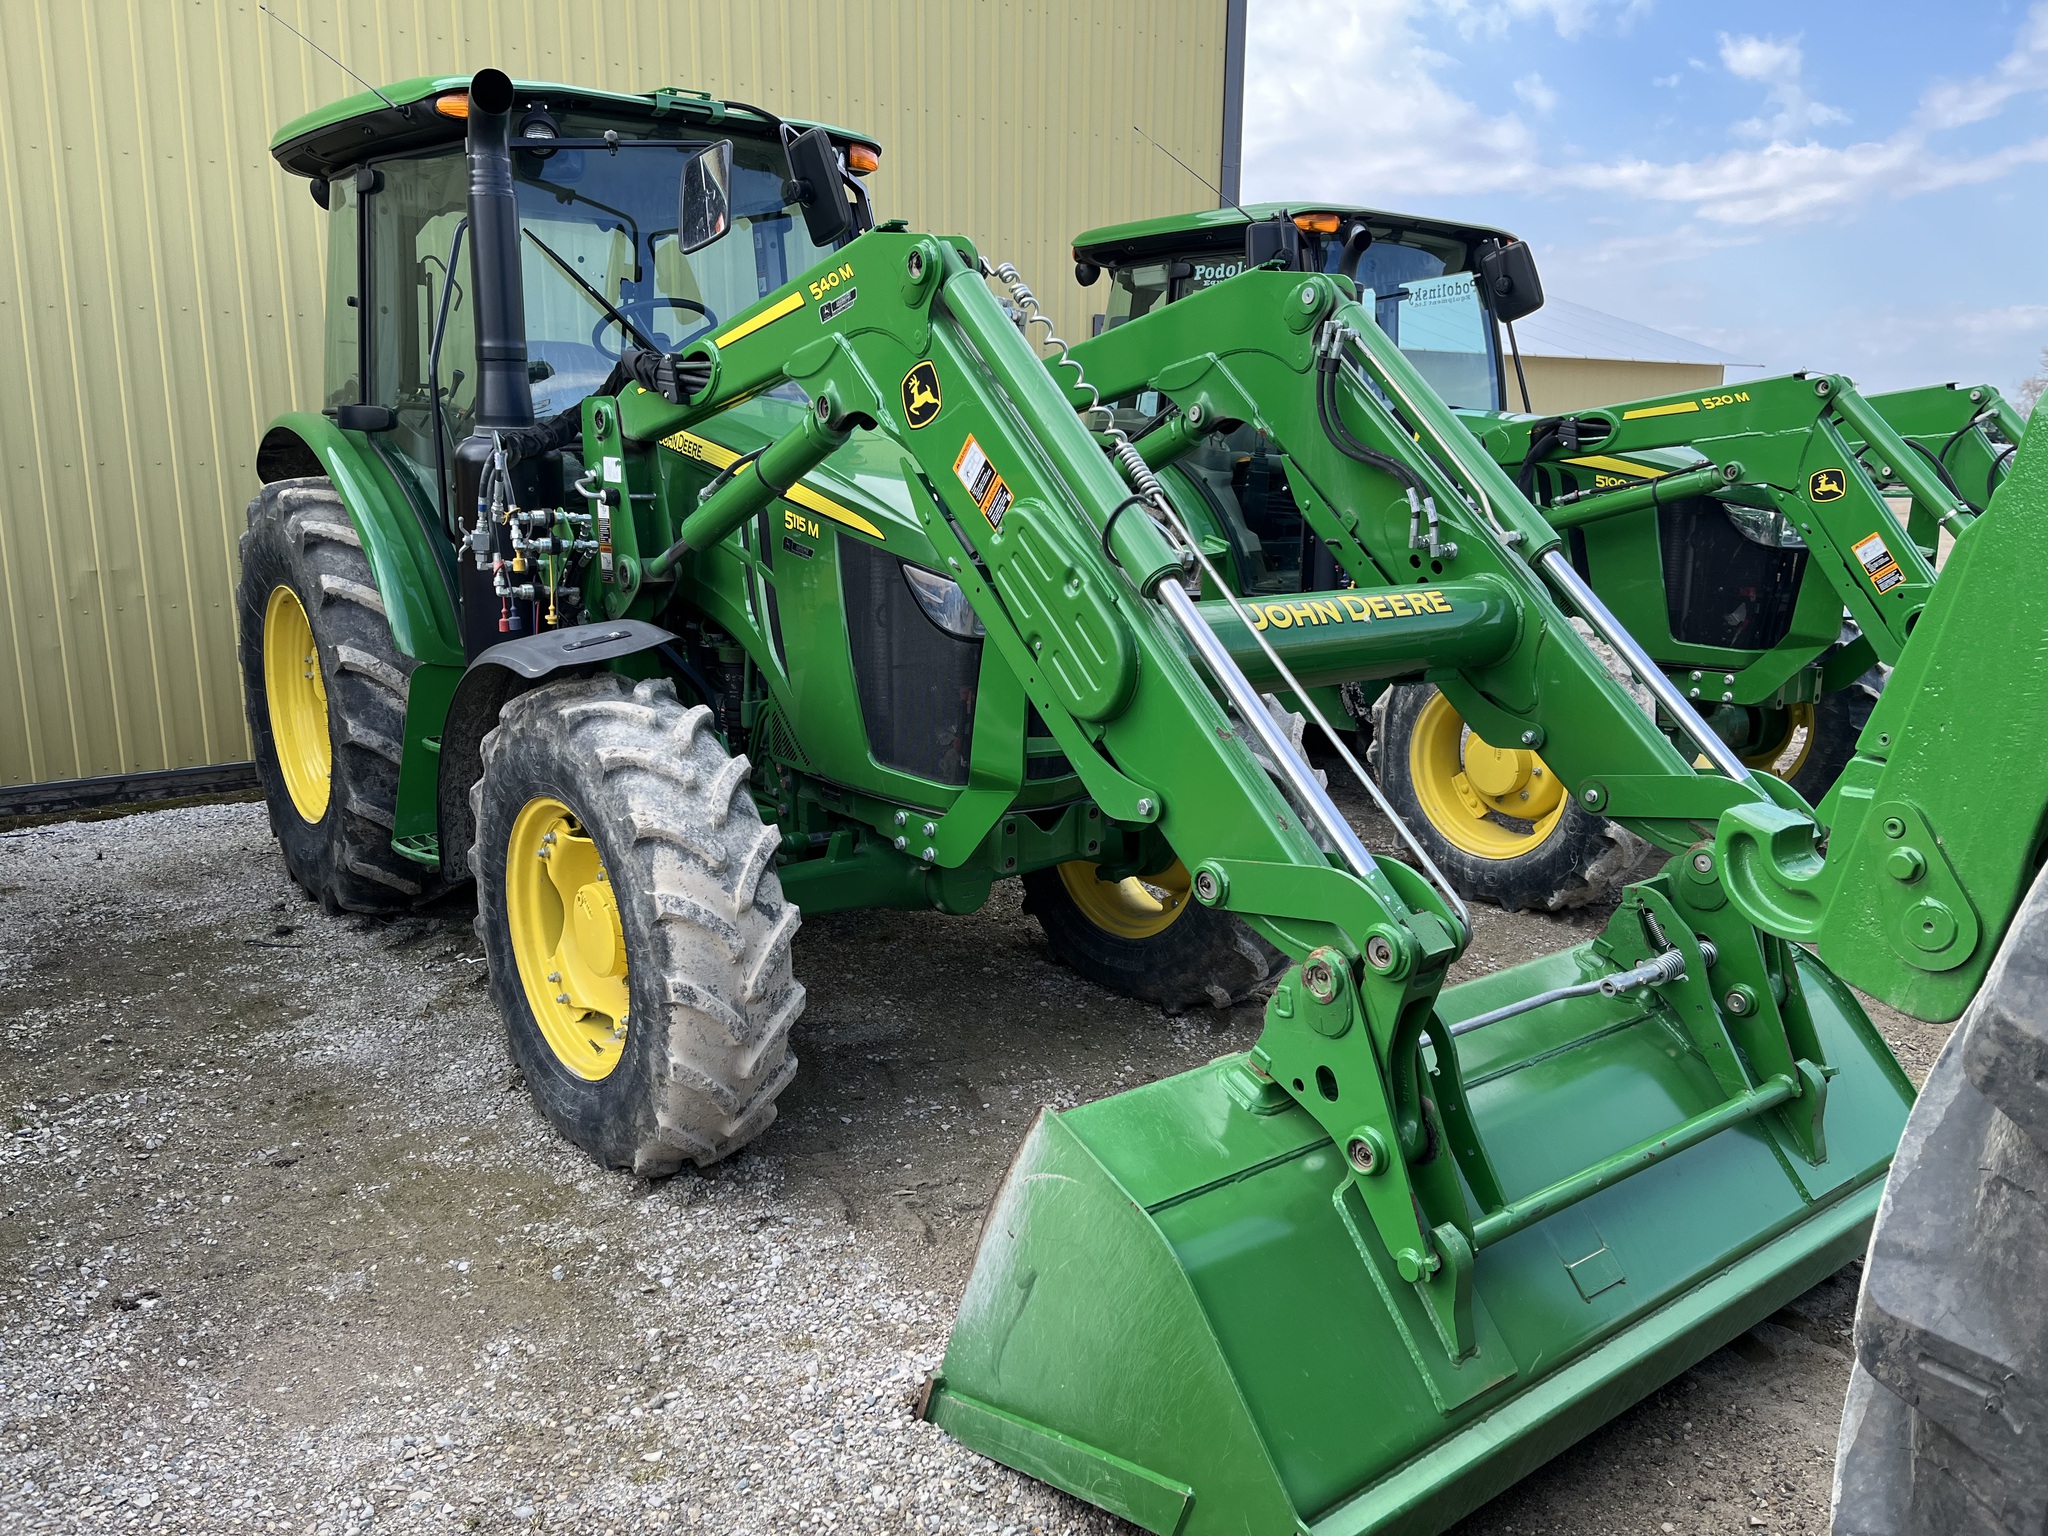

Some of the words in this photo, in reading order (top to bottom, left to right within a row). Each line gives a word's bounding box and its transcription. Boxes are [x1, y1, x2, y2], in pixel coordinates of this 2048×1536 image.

[808, 271, 840, 301] 540
[837, 262, 856, 282] M
[1193, 261, 1247, 280] Podol
[1701, 394, 1734, 410] 520
[1733, 391, 1751, 403] M
[677, 433, 703, 461] DEERE
[784, 509, 806, 533] 5115
[807, 519, 819, 540] M
[1248, 600, 1344, 632] JOHN
[1336, 590, 1453, 623] DEERE
